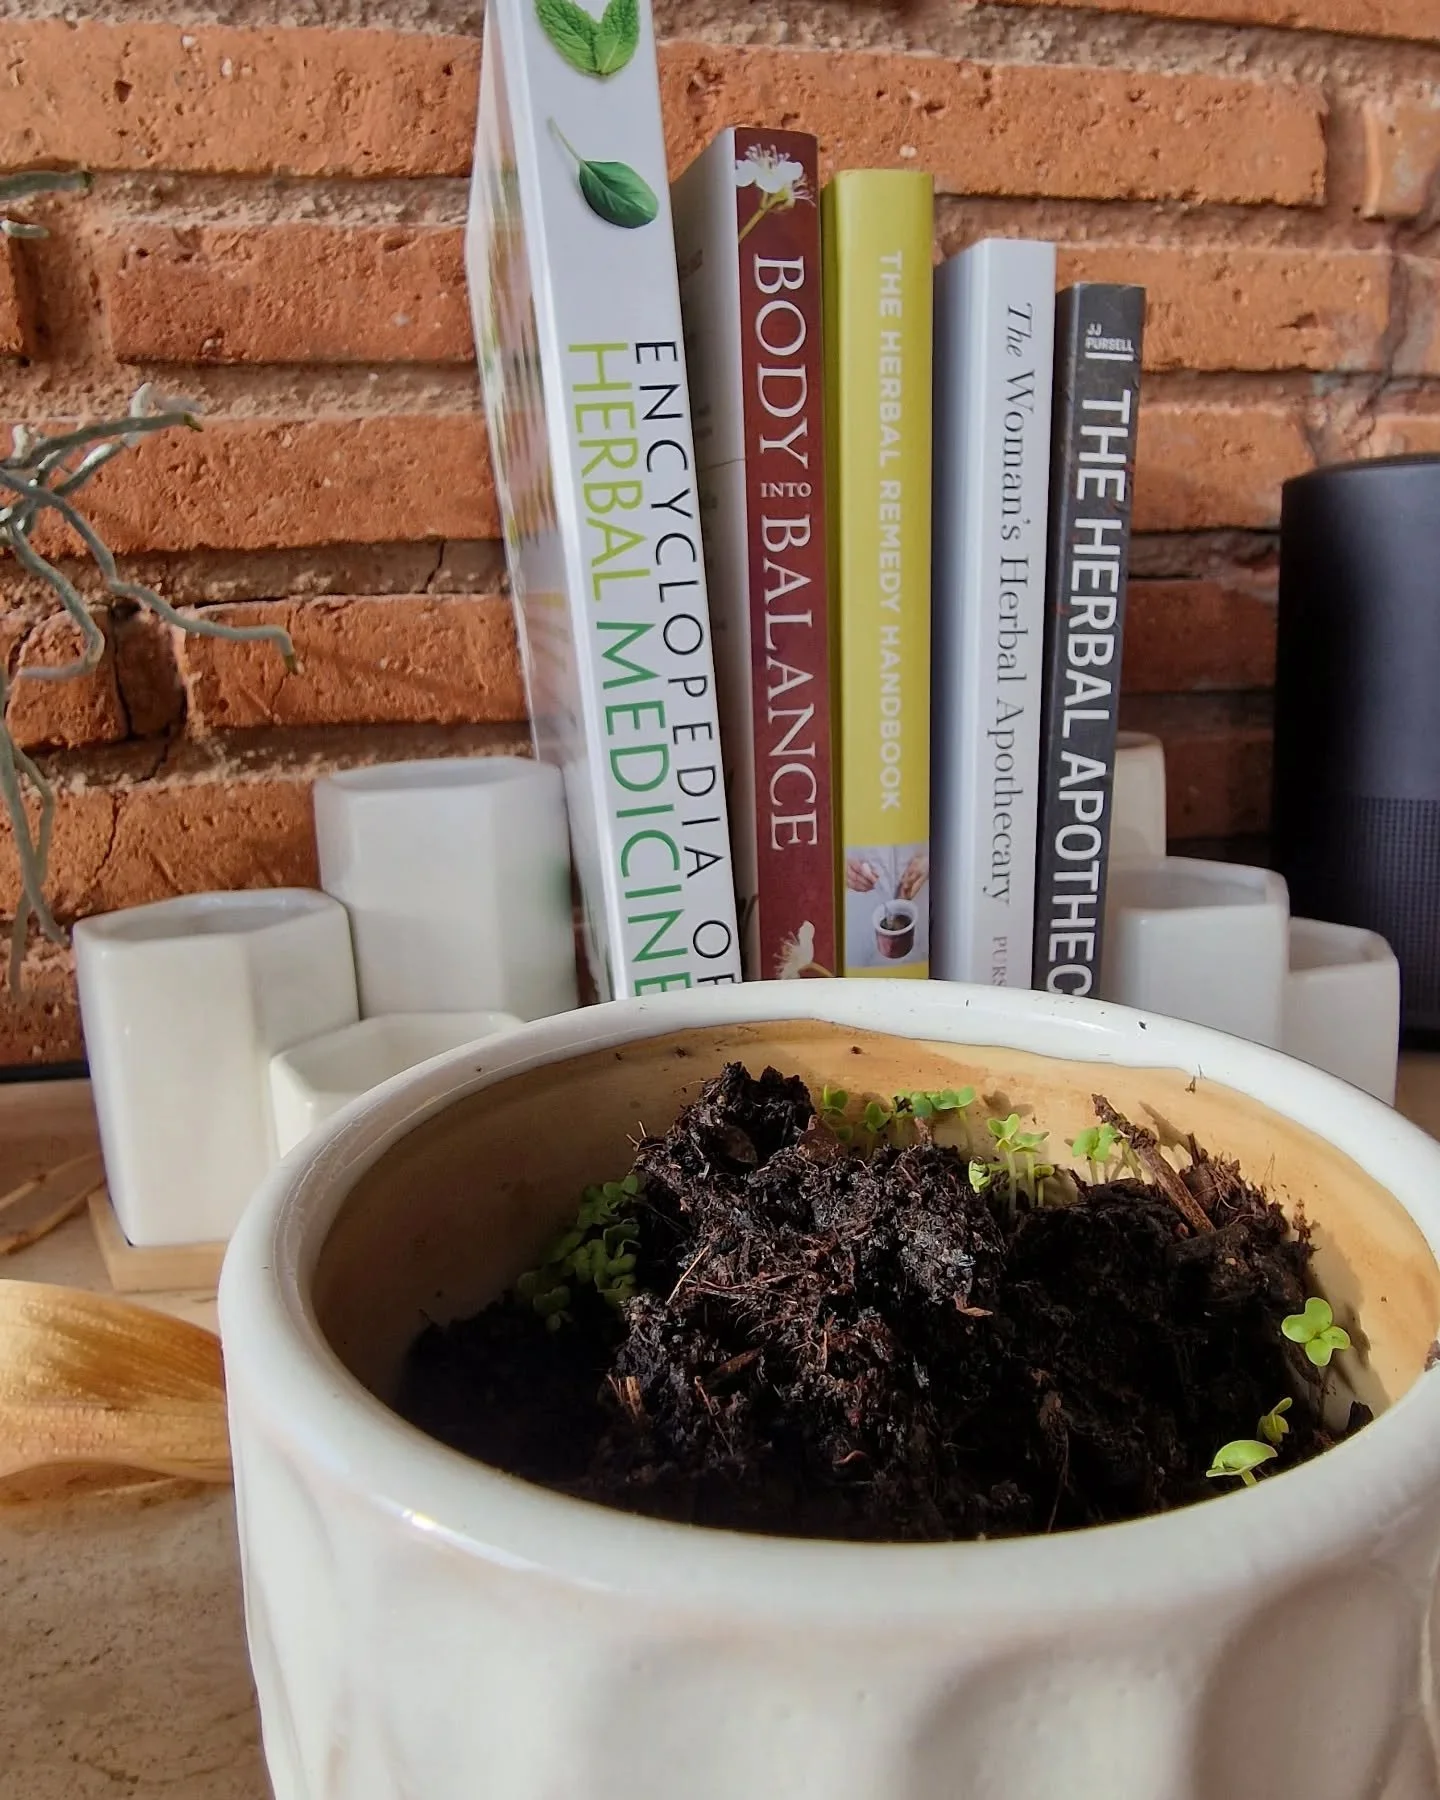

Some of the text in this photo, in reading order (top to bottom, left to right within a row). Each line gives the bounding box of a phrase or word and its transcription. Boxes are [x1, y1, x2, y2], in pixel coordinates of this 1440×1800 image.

[635, 341, 725, 878] ENCYCLOPEDIA
[753, 254, 809, 470] BODY
[760, 481, 813, 499] INTO
[878, 250, 903, 811] THE HERBAL REMEDY HANDBOOK
[982, 301, 1036, 906] The Woman's Herbal Apothecary
[568, 342, 692, 996] HERBAL MEDICINE
[761, 513, 819, 851] BALANCE
[1046, 388, 1131, 997] THE HERBAL APOTHEC
